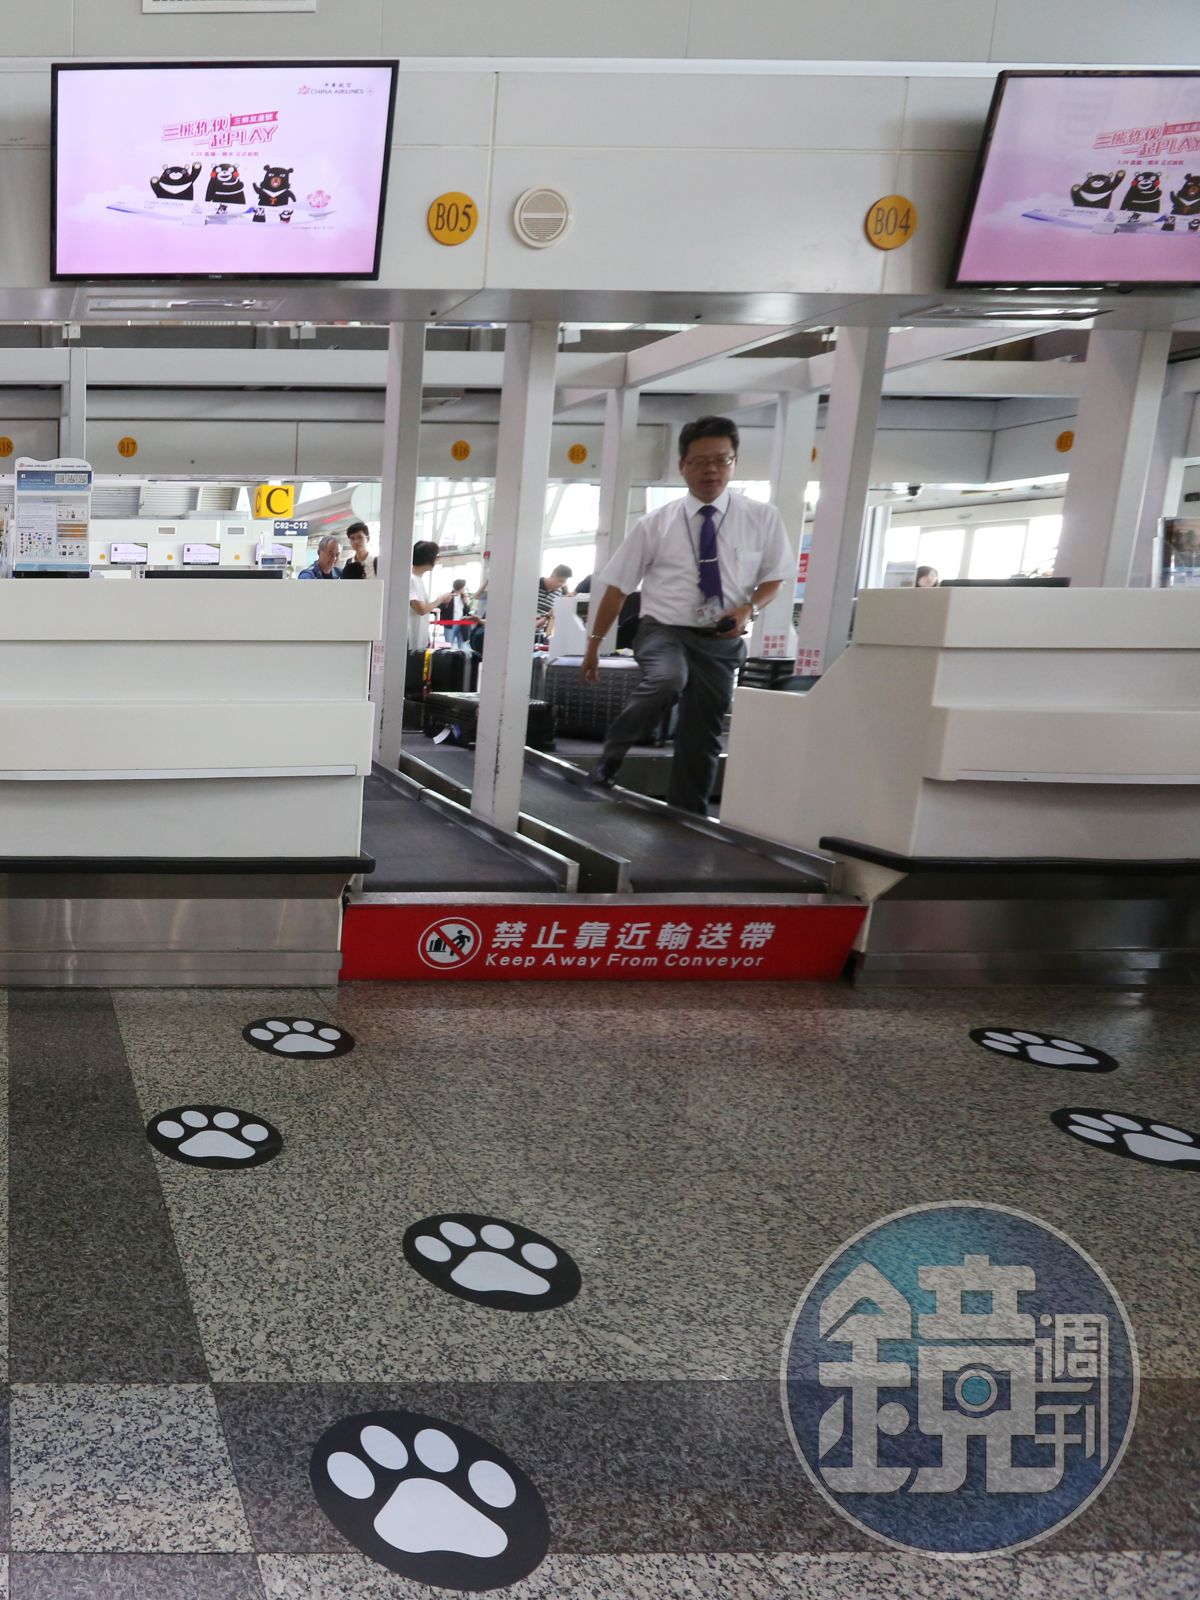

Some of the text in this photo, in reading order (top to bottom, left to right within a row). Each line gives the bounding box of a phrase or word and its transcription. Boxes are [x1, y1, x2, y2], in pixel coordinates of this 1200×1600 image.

[434, 203, 472, 232] B05
[873, 207, 911, 237] B04
[266, 488, 289, 515] C
[491, 920, 777, 951] 禁止靠近輸送帶
[485, 953, 764, 970] Keep Away From Conveyor
